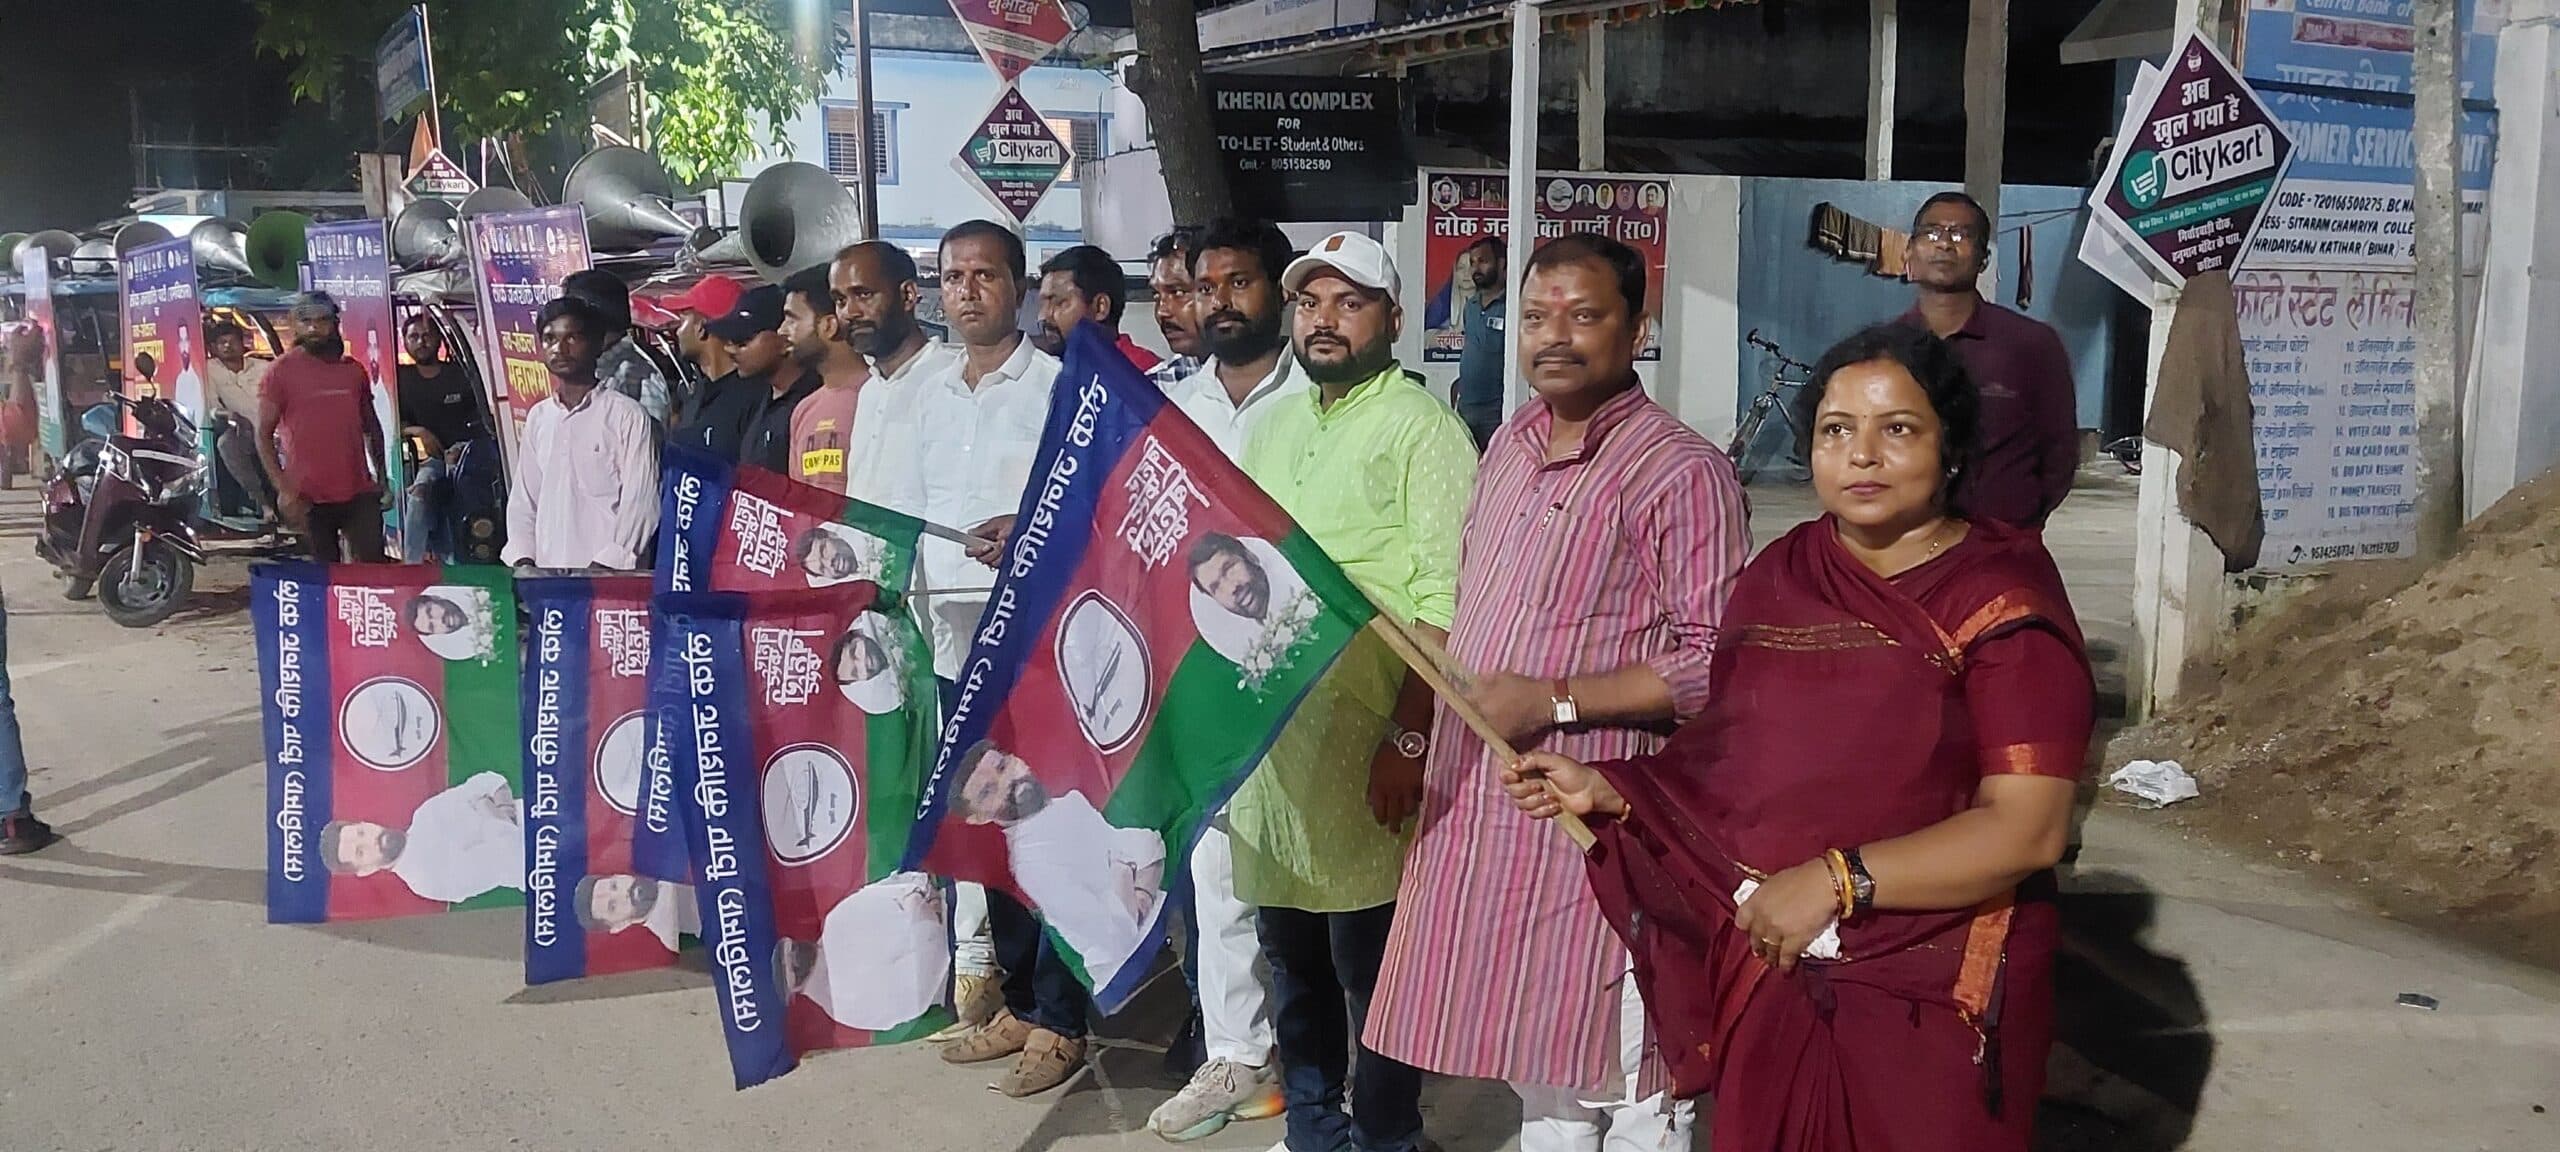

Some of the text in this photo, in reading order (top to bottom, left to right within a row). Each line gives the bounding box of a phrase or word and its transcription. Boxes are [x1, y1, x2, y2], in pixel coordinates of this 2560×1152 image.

[1217, 91, 1375, 110] KHERIA COMPLEX
[2181, 78, 2210, 107] अब
[1005, 109, 1022, 121] अब
[1277, 117, 1300, 130] FOR
[2152, 93, 2240, 148] खुल गया है
[988, 121, 1041, 139] खुल गया है
[999, 141, 1054, 162] Citykart
[1332, 137, 1364, 151] Others
[2352, 126, 2415, 169] SERVIC
[1272, 159, 1331, 170] 8051582580
[2171, 129, 2263, 181] Citykart
[2279, 192, 2304, 208] CODE
[2386, 197, 2401, 213] BC
[1435, 212, 1477, 237] लोक
[2288, 217, 2329, 232] SITARAM
[2331, 219, 2378, 234] CHAMRIYA
[2384, 222, 2414, 234] COLLE
[2319, 241, 2361, 256] KATIHAR
